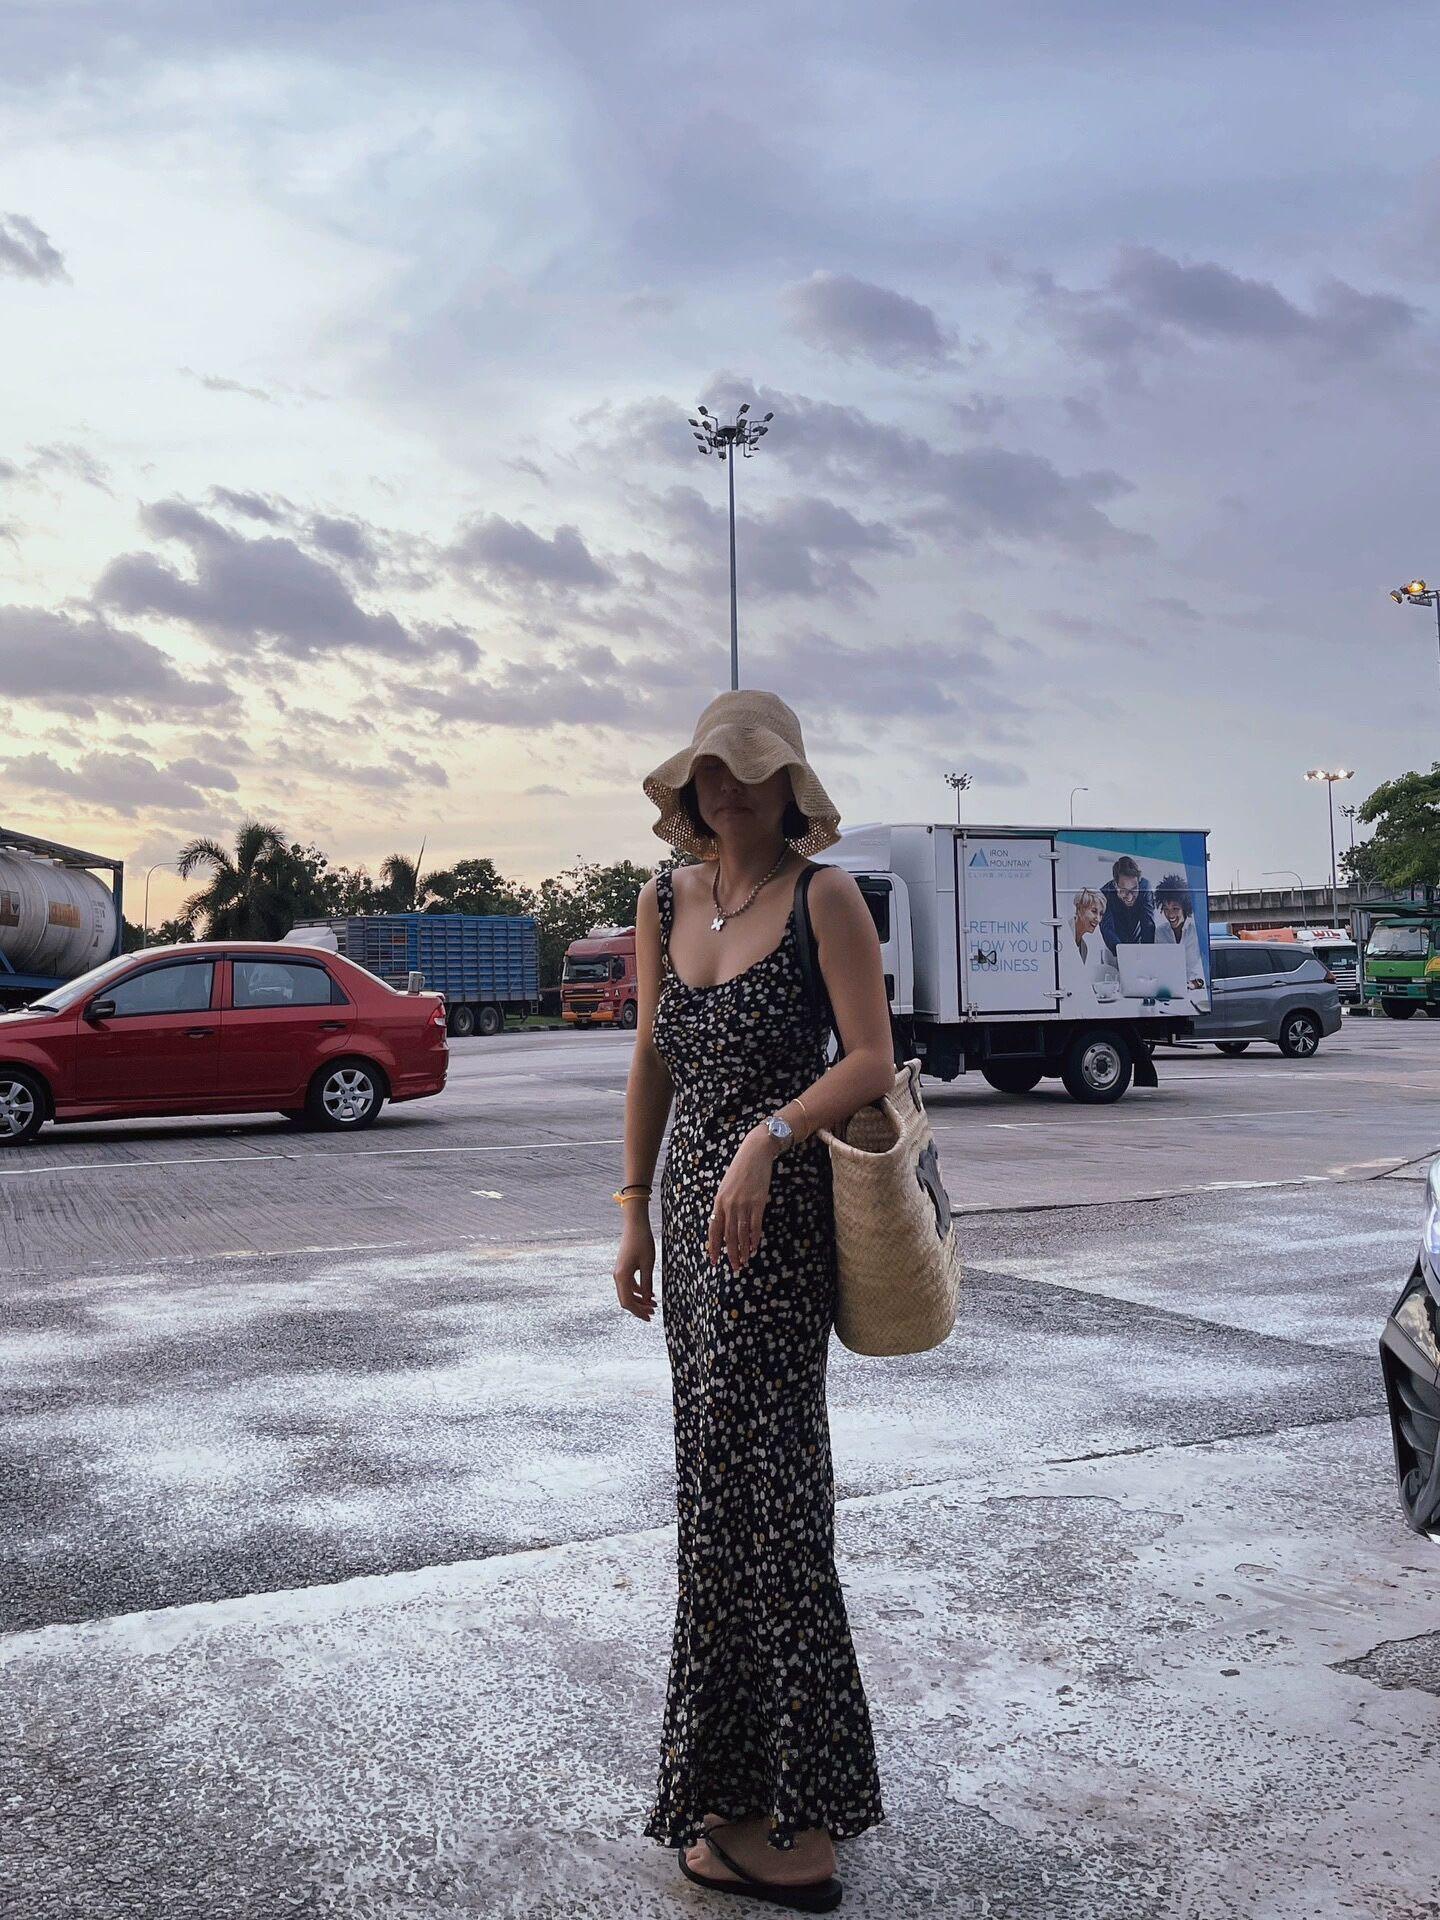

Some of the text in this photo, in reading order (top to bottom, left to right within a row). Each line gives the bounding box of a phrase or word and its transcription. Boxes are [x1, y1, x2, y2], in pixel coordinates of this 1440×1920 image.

[989, 849, 1009, 857] IRON
[970, 921, 1030, 934] RETHINK
[970, 940, 1063, 953] HOW YOU DO
[971, 959, 1039, 972] BUSINESS
